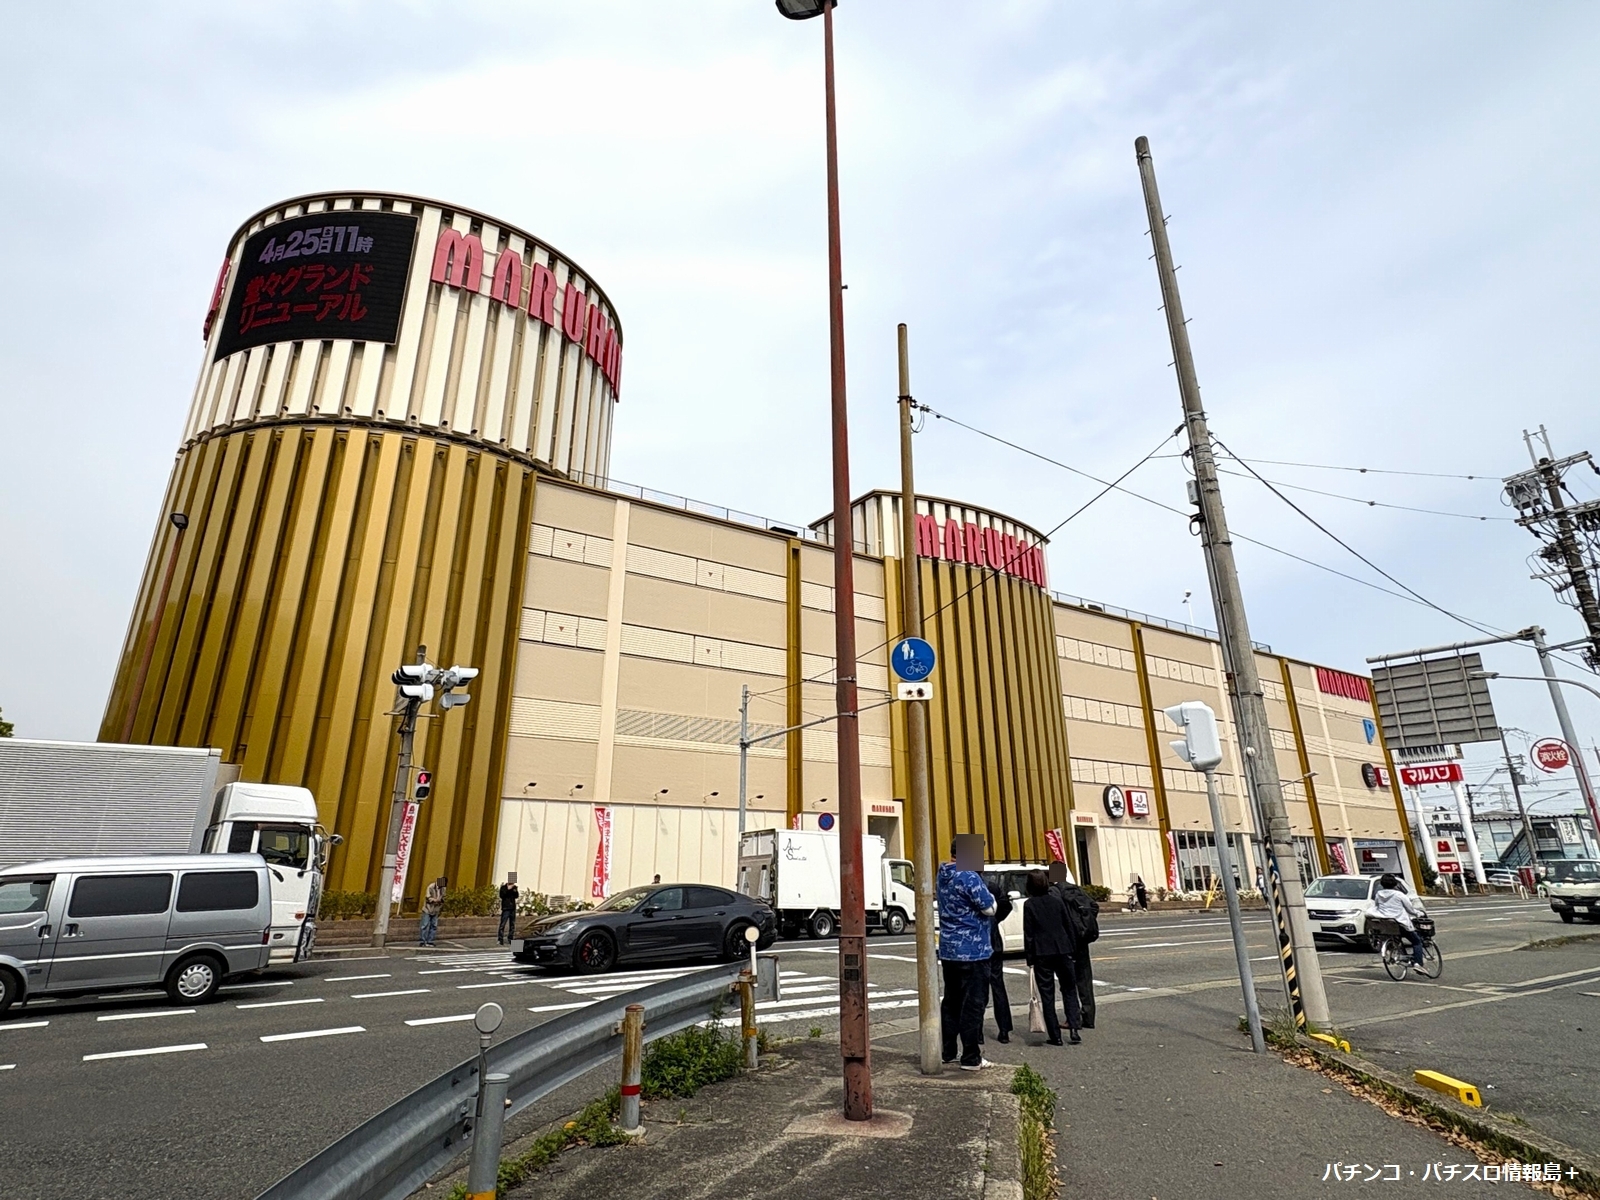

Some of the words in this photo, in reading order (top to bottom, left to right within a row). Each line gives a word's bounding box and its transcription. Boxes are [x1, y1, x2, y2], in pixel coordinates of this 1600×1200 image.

[239, 293, 369, 335] リニューアル
[914, 513, 1046, 588] MARUHAN
[1316, 667, 1370, 703] MARUHAN
[1362, 719, 1376, 745] P
[1539, 750, 1567, 763] 消火栓
[1406, 766, 1451, 782] マルハン
